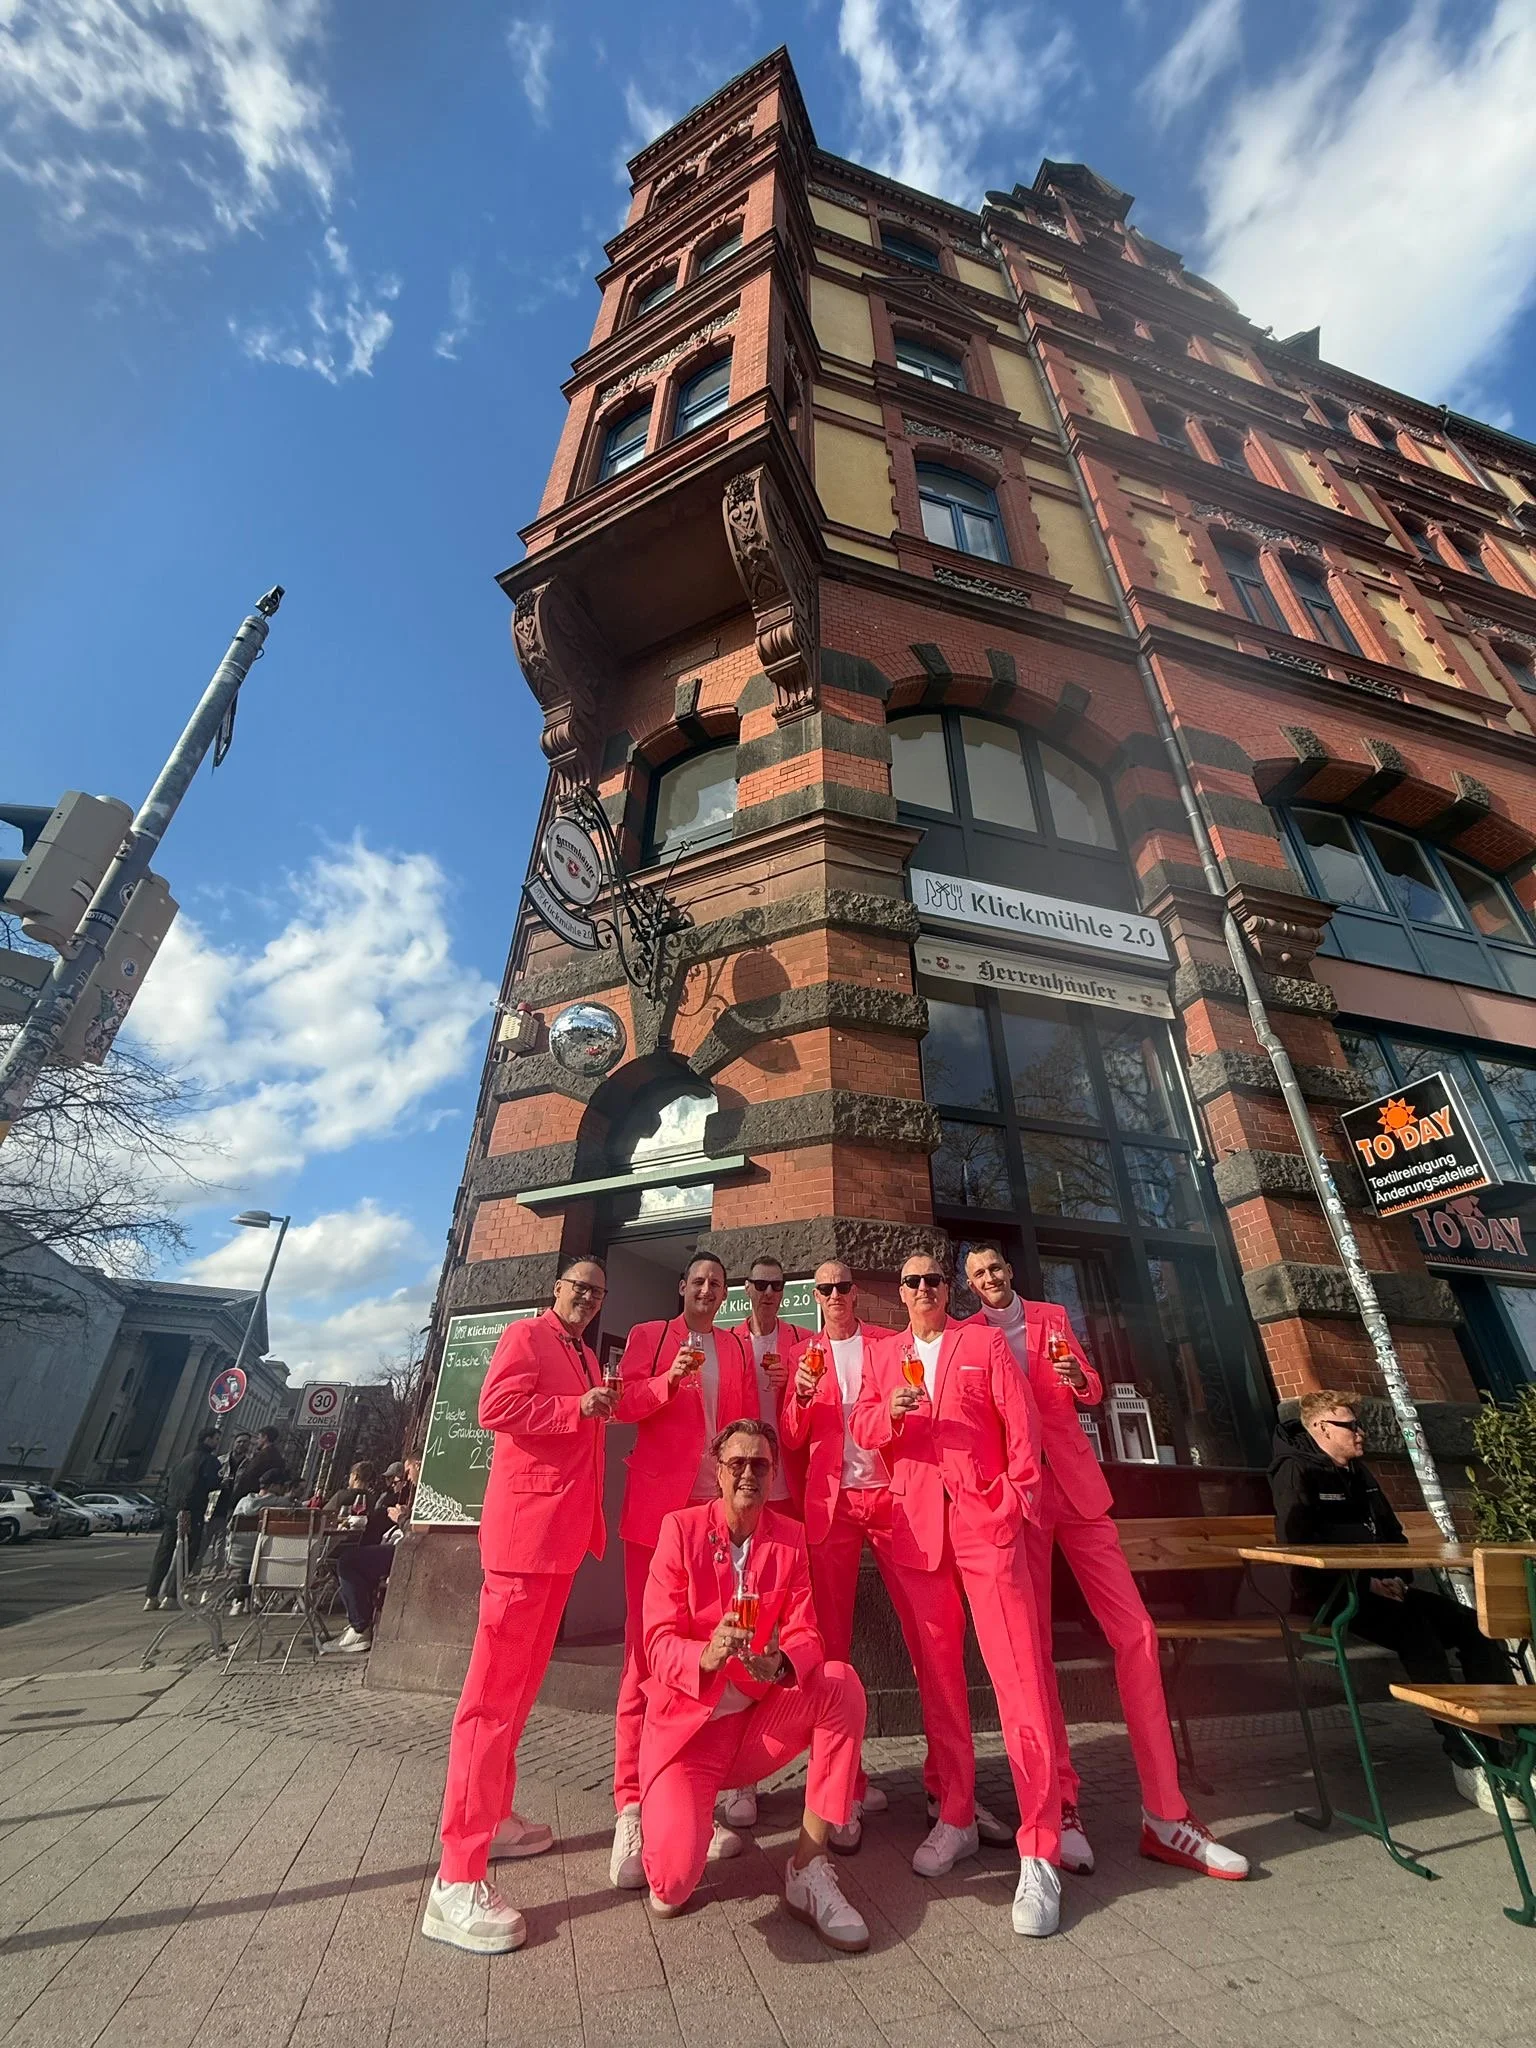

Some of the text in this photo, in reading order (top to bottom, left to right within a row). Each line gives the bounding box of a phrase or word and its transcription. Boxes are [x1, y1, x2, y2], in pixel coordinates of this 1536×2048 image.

[542, 898, 582, 937] Klickmühle
[971, 892, 1156, 948] Klickmühle 2.0
[1369, 1151, 1457, 1190] Textilreinigung
[1375, 1162, 1479, 1205] Änderungsatelier
[793, 1293, 811, 1307] 2.0
[467, 1322, 508, 1337] Klickmühl
[446, 1352, 480, 1368] Flasche
[314, 1394, 332, 1408] 30
[307, 1416, 330, 1425] ZONE
